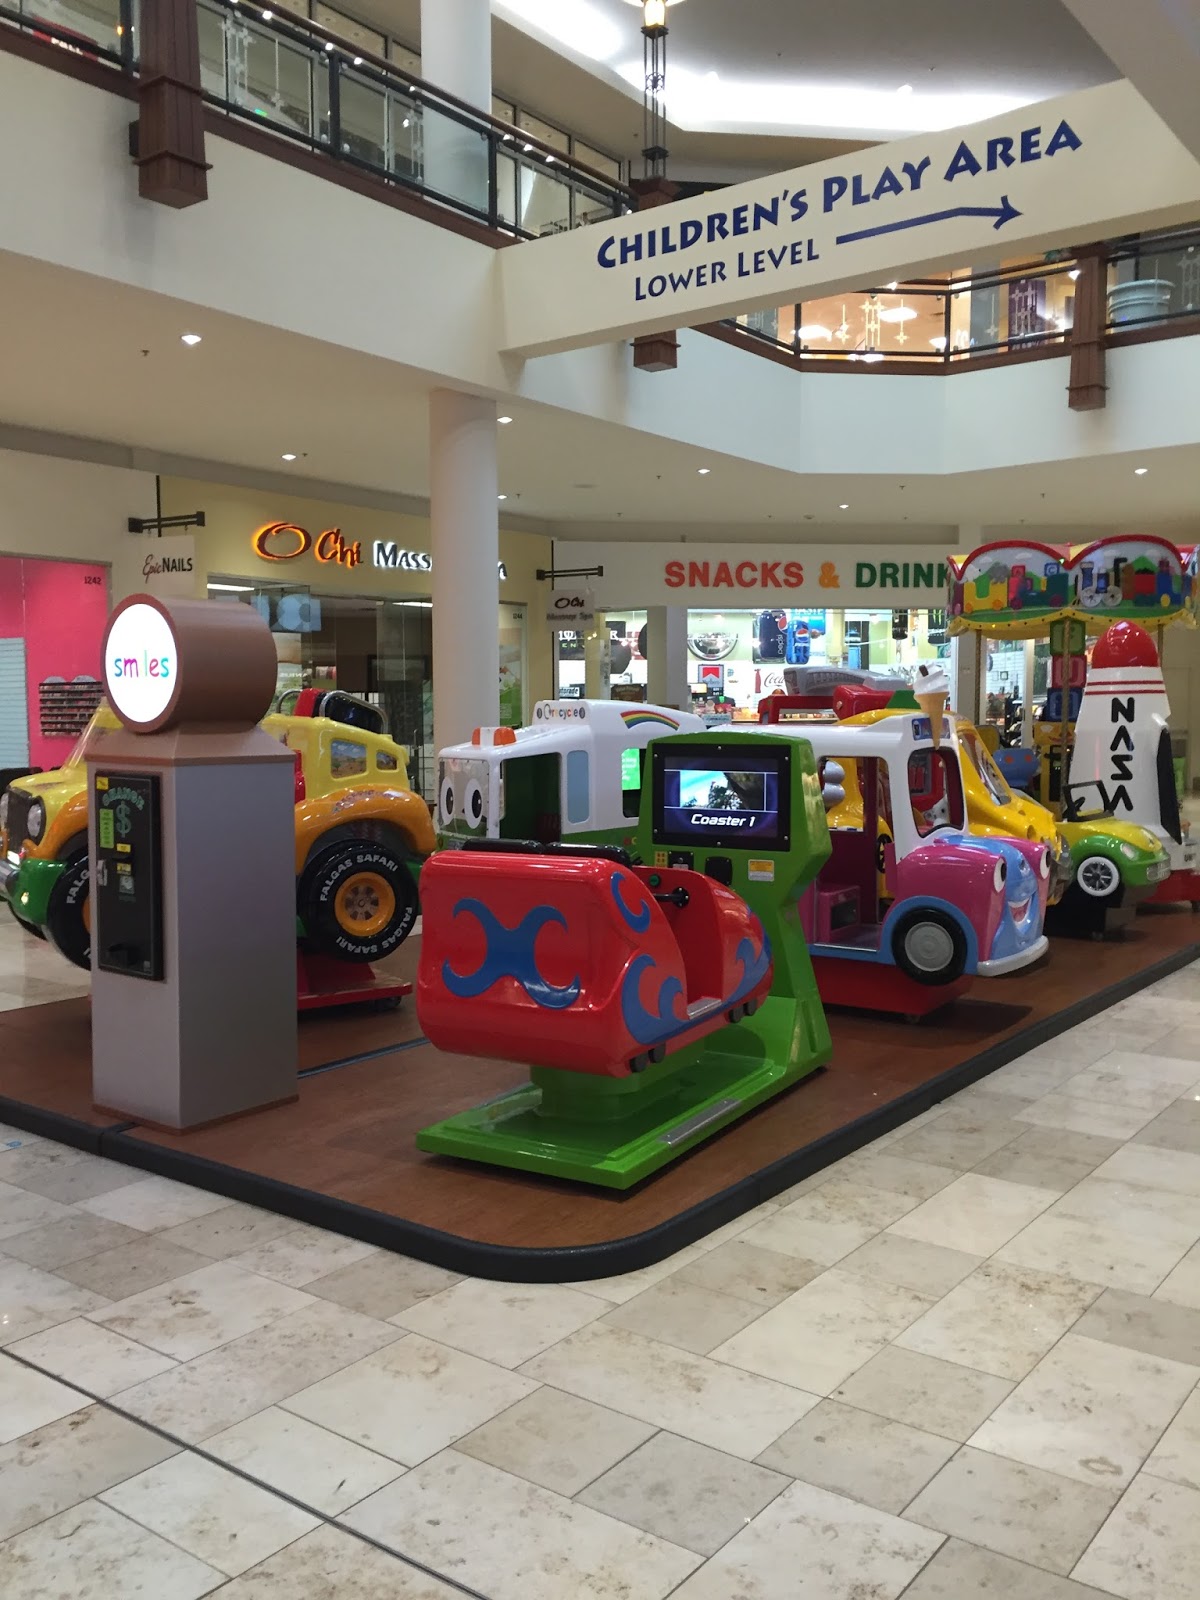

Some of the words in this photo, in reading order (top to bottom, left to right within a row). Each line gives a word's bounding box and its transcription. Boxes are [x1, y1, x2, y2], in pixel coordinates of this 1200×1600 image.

[597, 188, 809, 269] CHILDREN'S
[823, 155, 931, 213] PLAY
[943, 119, 1083, 182] AREA
[635, 261, 727, 301] LOWER
[738, 238, 819, 277] LEVEL
[253, 522, 312, 560] O
[316, 528, 364, 567] Chi
[84, 576, 102, 586] 1242
[664, 561, 804, 588] SNACKS
[818, 561, 840, 588] &
[691, 813, 747, 827] Coaster
[749, 816, 756, 828] 1
[320, 858, 354, 902] FALGAS
[356, 853, 399, 872] SAFARI
[336, 936, 378, 954] SAFARI
[381, 906, 414, 949] FALGAS
